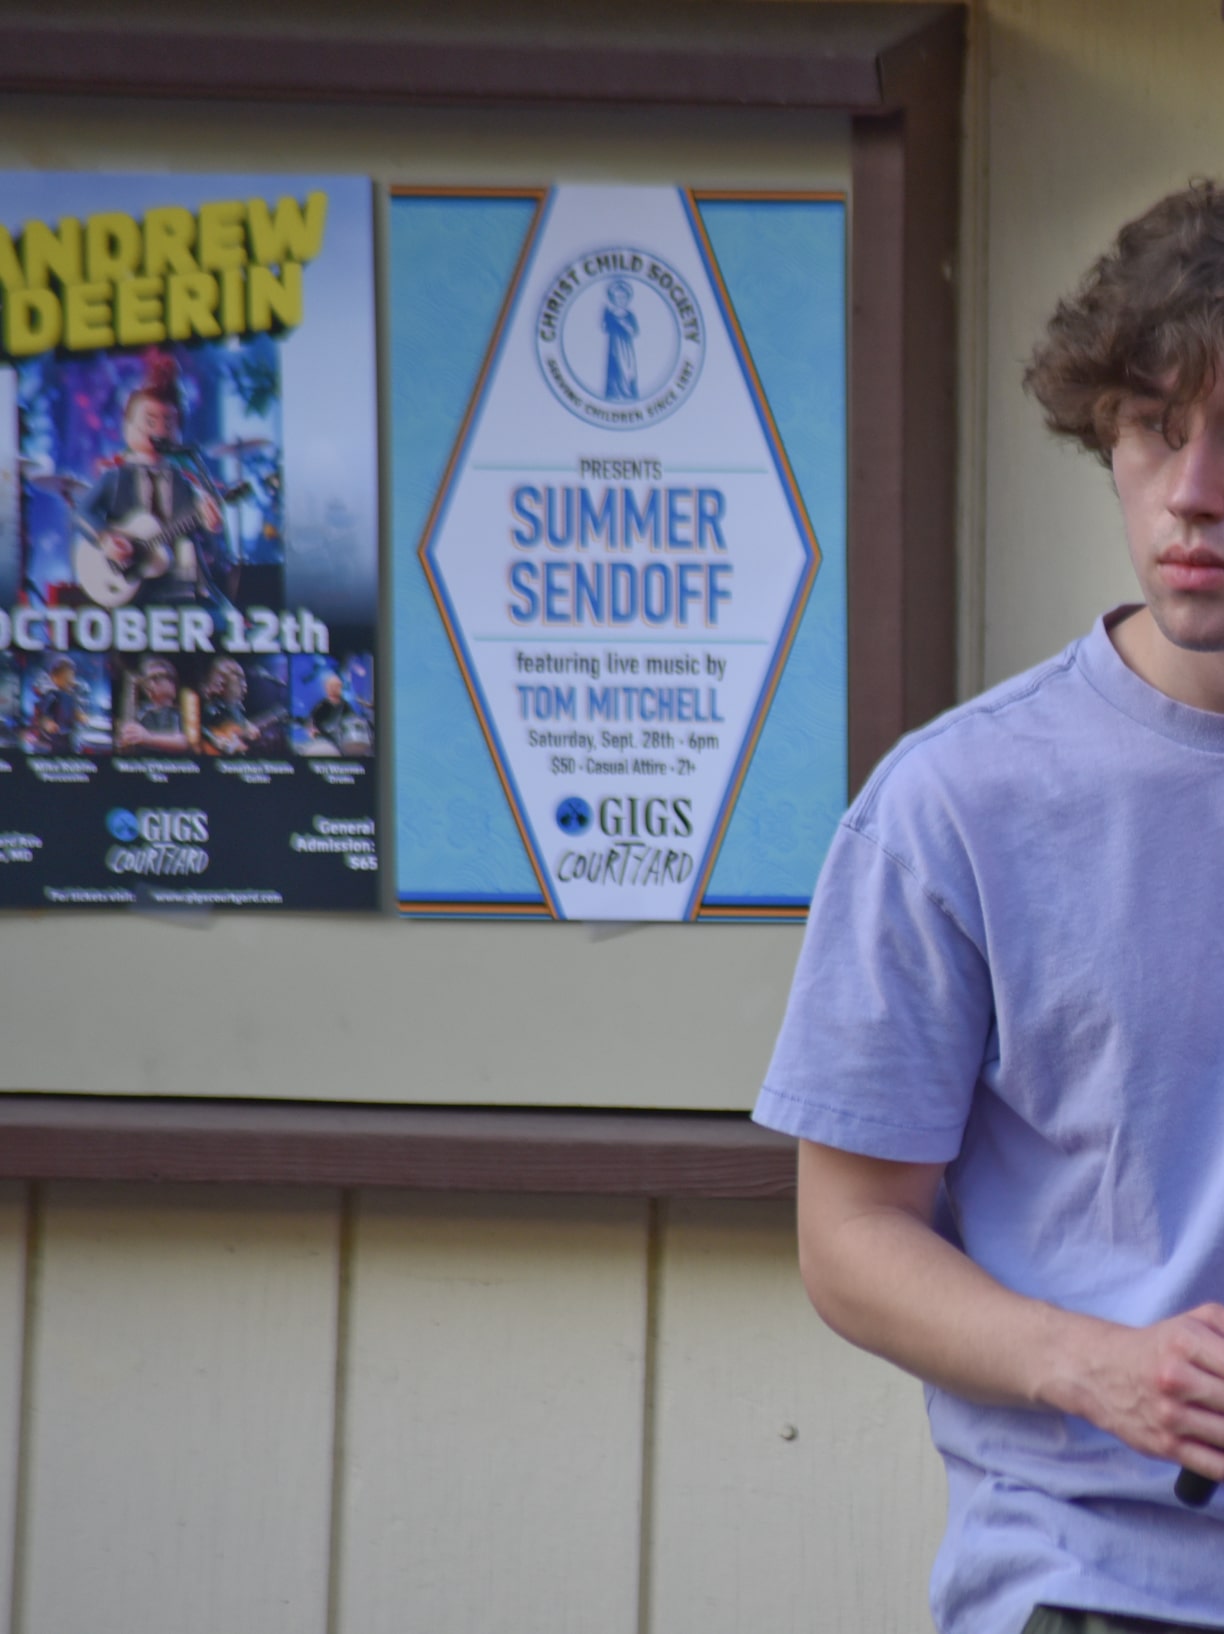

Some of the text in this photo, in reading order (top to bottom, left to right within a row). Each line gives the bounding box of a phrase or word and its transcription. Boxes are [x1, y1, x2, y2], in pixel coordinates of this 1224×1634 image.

[5, 262, 303, 356] DEERIN
[540, 254, 701, 344] CHRIST CHILD SOCIETY
[580, 459, 662, 480] PRESENTS
[511, 485, 729, 552] SUMMER
[508, 561, 734, 627] SENDOFF
[0, 607, 330, 653] CTOBER 12th
[517, 652, 727, 680] featuring live music by
[516, 685, 725, 723] TOM MITCHELL
[528, 730, 597, 751] Saturday,
[602, 731, 637, 752] Sept.
[642, 732, 675, 749] 28th
[688, 733, 719, 753] 6pm
[586, 757, 629, 775] Casual
[632, 758, 667, 775] Attire
[139, 810, 209, 842] GIGS
[318, 817, 375, 836] General
[599, 797, 694, 838] GIGS
[110, 842, 209, 876] COURTYARD
[297, 835, 376, 853] Admission:
[557, 841, 694, 886] COURTYARD
